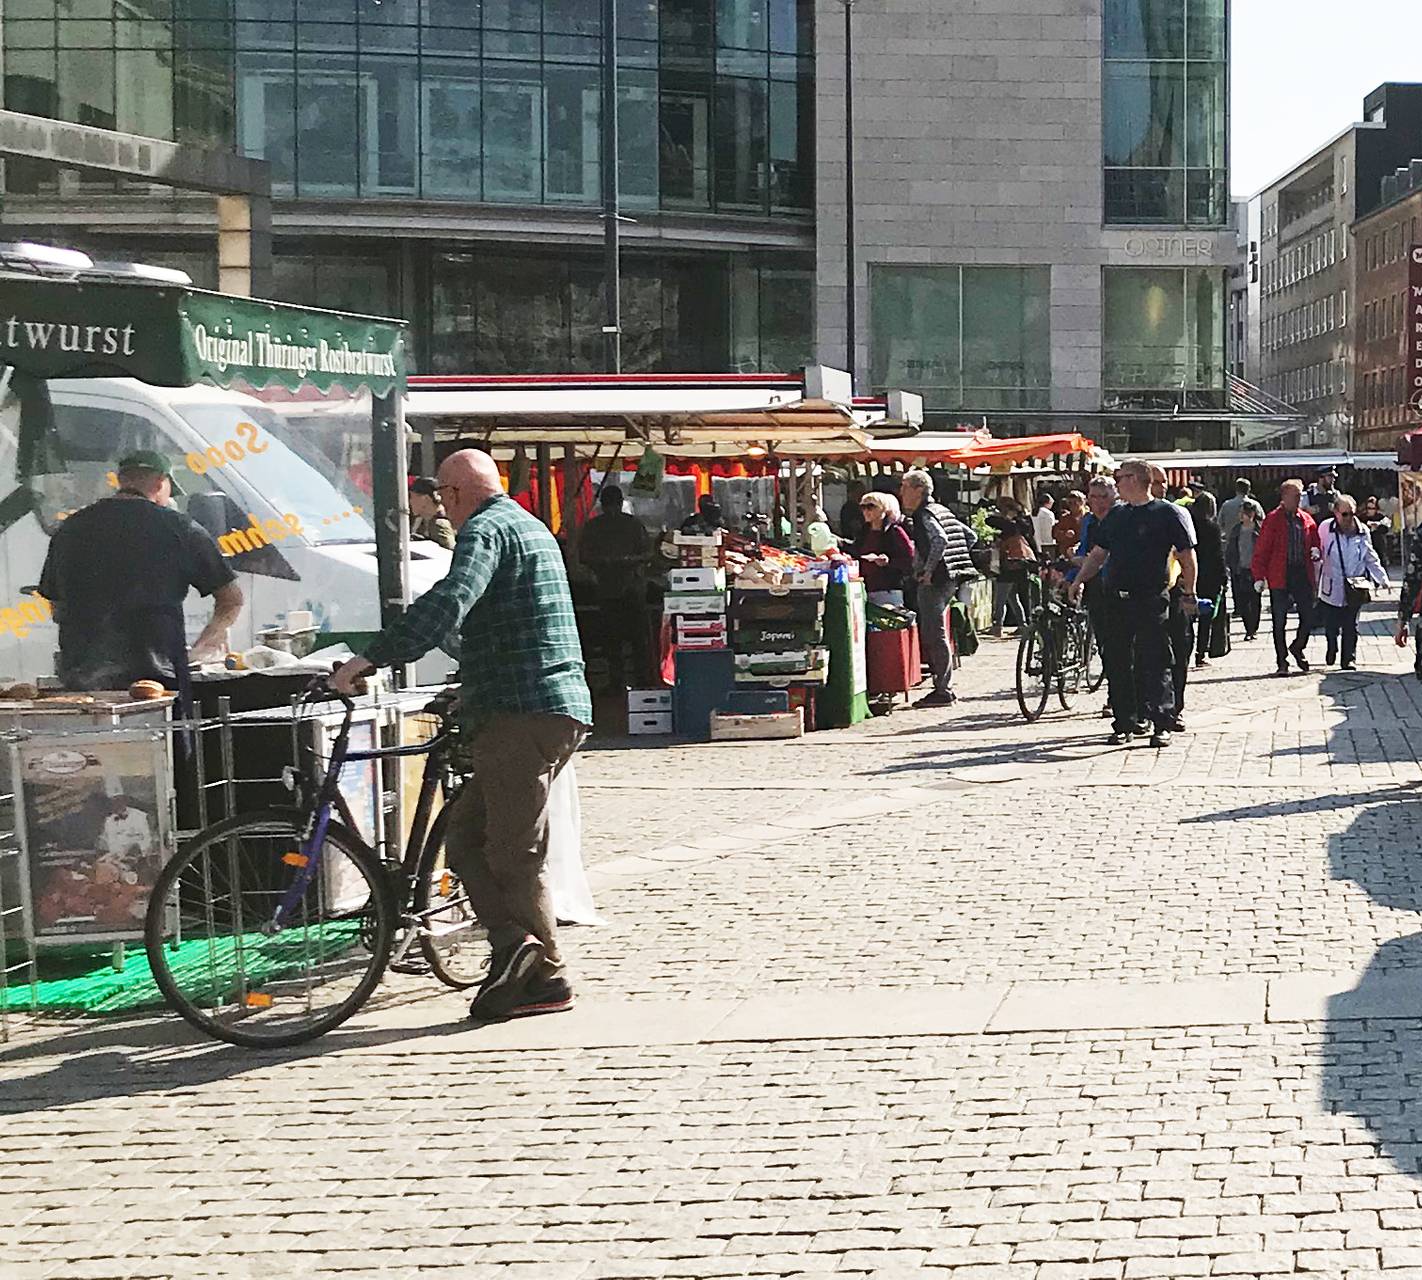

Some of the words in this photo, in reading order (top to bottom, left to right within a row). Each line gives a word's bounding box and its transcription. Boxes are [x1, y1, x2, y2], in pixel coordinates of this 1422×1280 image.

[0, 314, 136, 356] twurst
[195, 322, 253, 372] Original
[255, 331, 319, 378] Thüringer
[319, 338, 397, 377] Rostbratwurst
